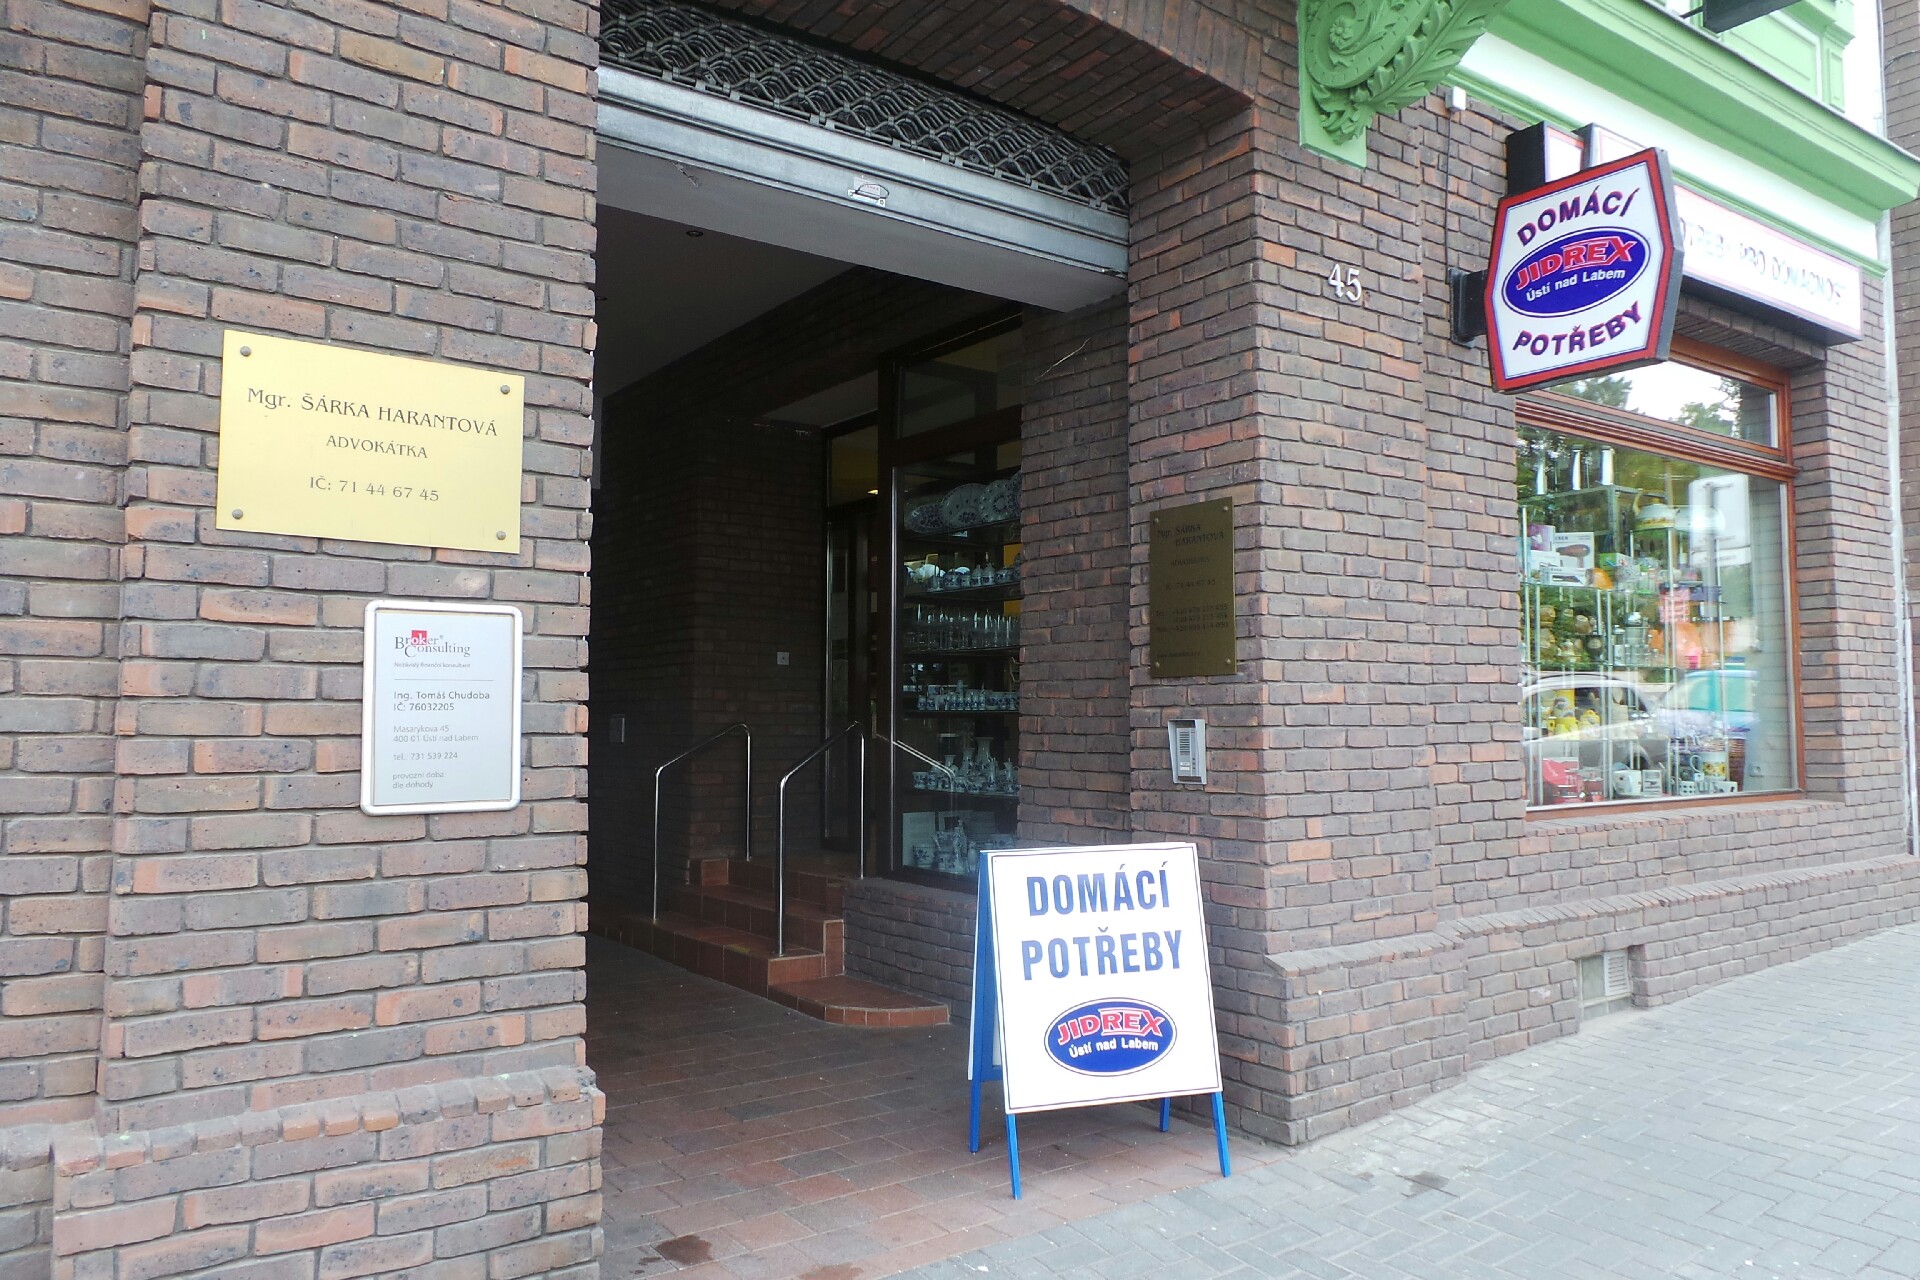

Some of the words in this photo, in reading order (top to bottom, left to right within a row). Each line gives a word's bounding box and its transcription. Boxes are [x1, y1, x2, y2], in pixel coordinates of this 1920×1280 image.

[1516, 184, 1641, 247] DOMÁCÍ
[1515, 235, 1637, 291] JIDREX
[1328, 263, 1362, 301] 45
[1525, 281, 1551, 302] Ústí
[1554, 273, 1578, 291] nad
[1582, 267, 1626, 284] Labem
[1511, 300, 1643, 356] POTŘEBY
[247, 387, 292, 409] Mgr.
[301, 393, 370, 418] ŠÁRKA
[378, 406, 498, 436] HARANTOVÁ
[325, 435, 428, 459] ADVOKÁTKA
[309, 475, 332, 491] IČ:
[338, 480, 357, 493] 71
[365, 482, 385, 496] 44
[392, 486, 413, 499] 67
[419, 488, 440, 502] 45
[395, 632, 439, 650] Broker
[404, 641, 471, 658] Consulting
[393, 691, 413, 701] Ing.
[416, 690, 446, 700] Tomáš
[448, 691, 490, 700] Chudoba
[393, 702, 406, 711] IČ:
[409, 702, 455, 712] 76032205
[393, 724, 438, 734] Masarykova
[439, 724, 450, 733] 45
[393, 735, 409, 743] 400
[454, 733, 479, 742] Labem
[410, 752, 425, 760] 731
[427, 752, 442, 760] 539
[443, 751, 458, 760] 224
[392, 781, 404, 789] dle
[405, 780, 434, 789] dohody
[1026, 860, 1170, 917] DOMÁCÍ
[1021, 926, 1182, 981] POTŘEBY
[1057, 1007, 1166, 1046] JIDREX
[1068, 1038, 1093, 1058] Ústí
[1096, 1037, 1117, 1051] nad
[1121, 1036, 1159, 1052] Labem
